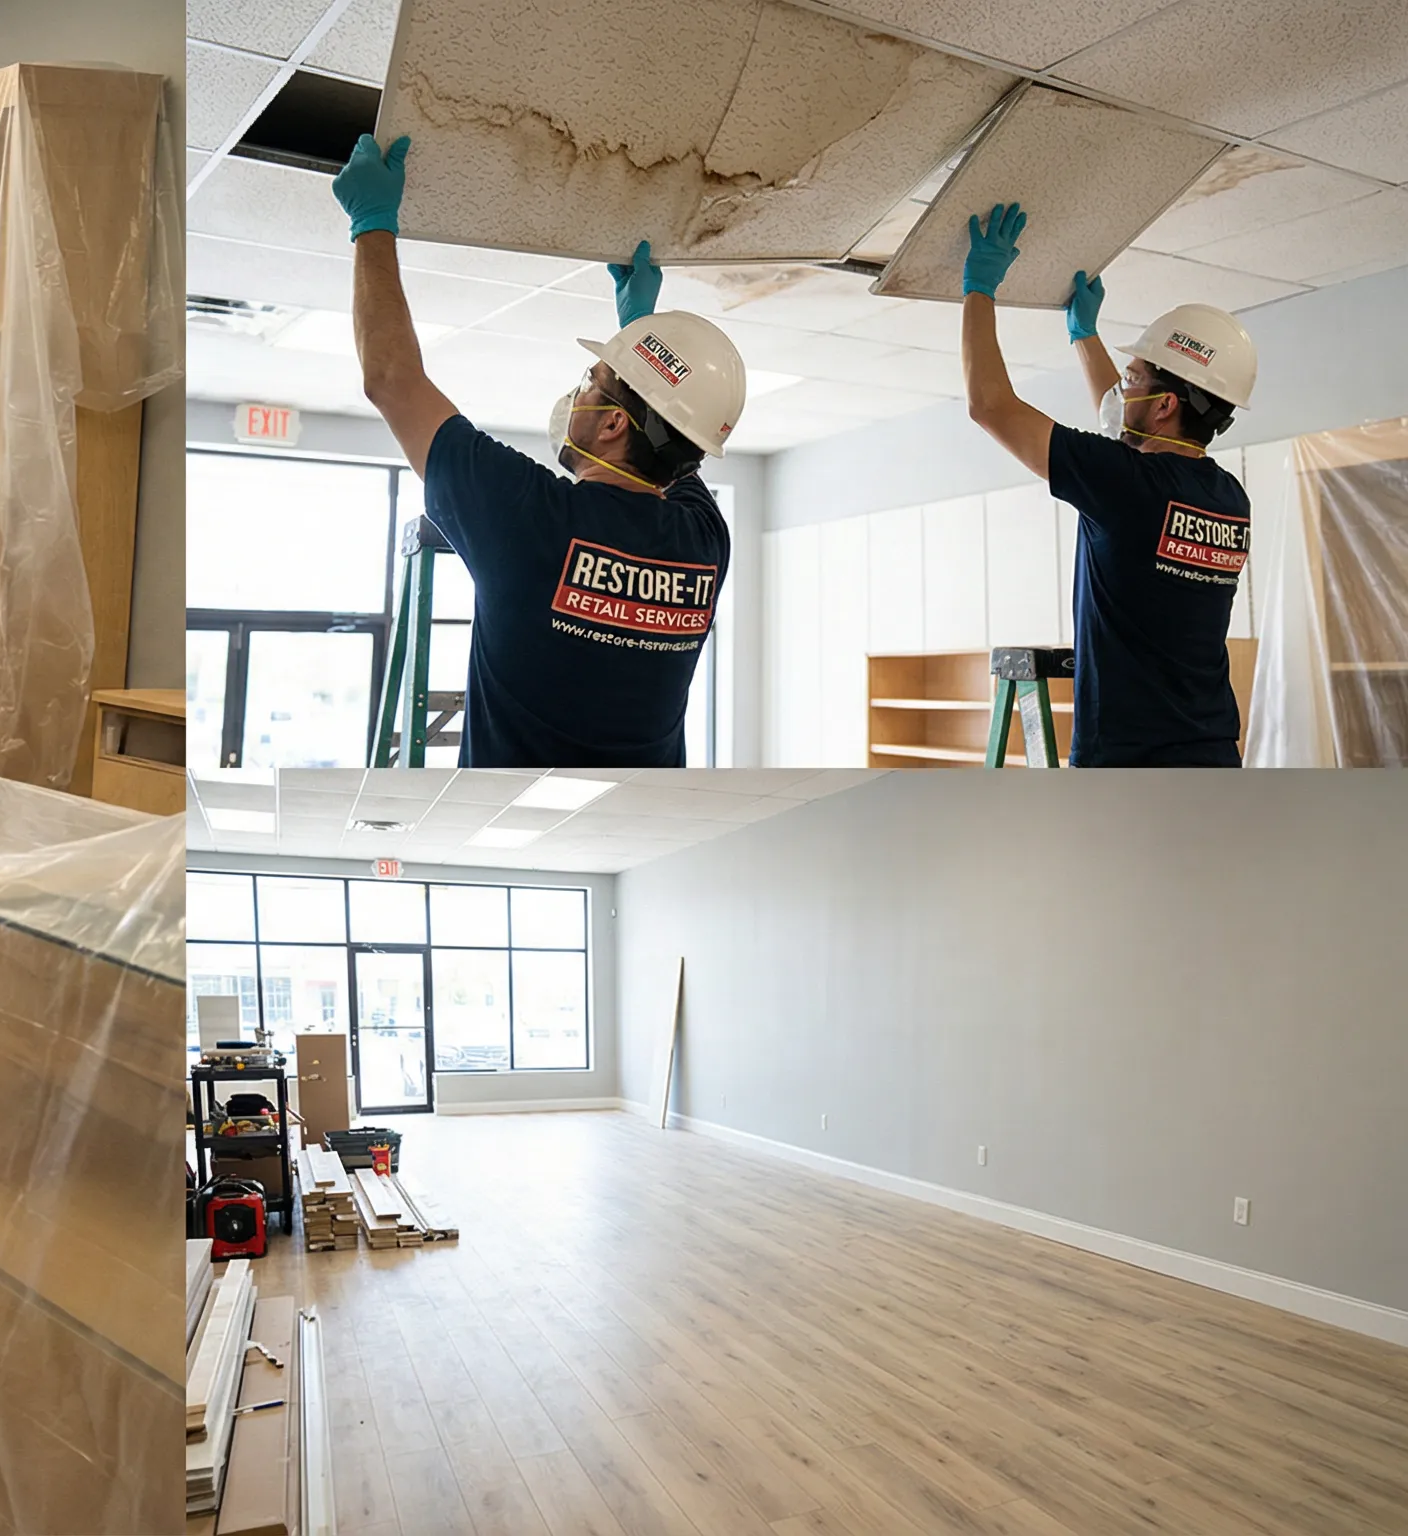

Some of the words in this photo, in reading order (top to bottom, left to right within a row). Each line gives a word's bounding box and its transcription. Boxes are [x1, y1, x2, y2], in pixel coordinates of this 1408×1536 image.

[248, 407, 291, 438] EXIT
[1166, 540, 1208, 561] RETAIL
[571, 551, 713, 605] RESTORE-IT
[565, 591, 629, 620] RETAIL
[635, 608, 706, 628] SERVICES
